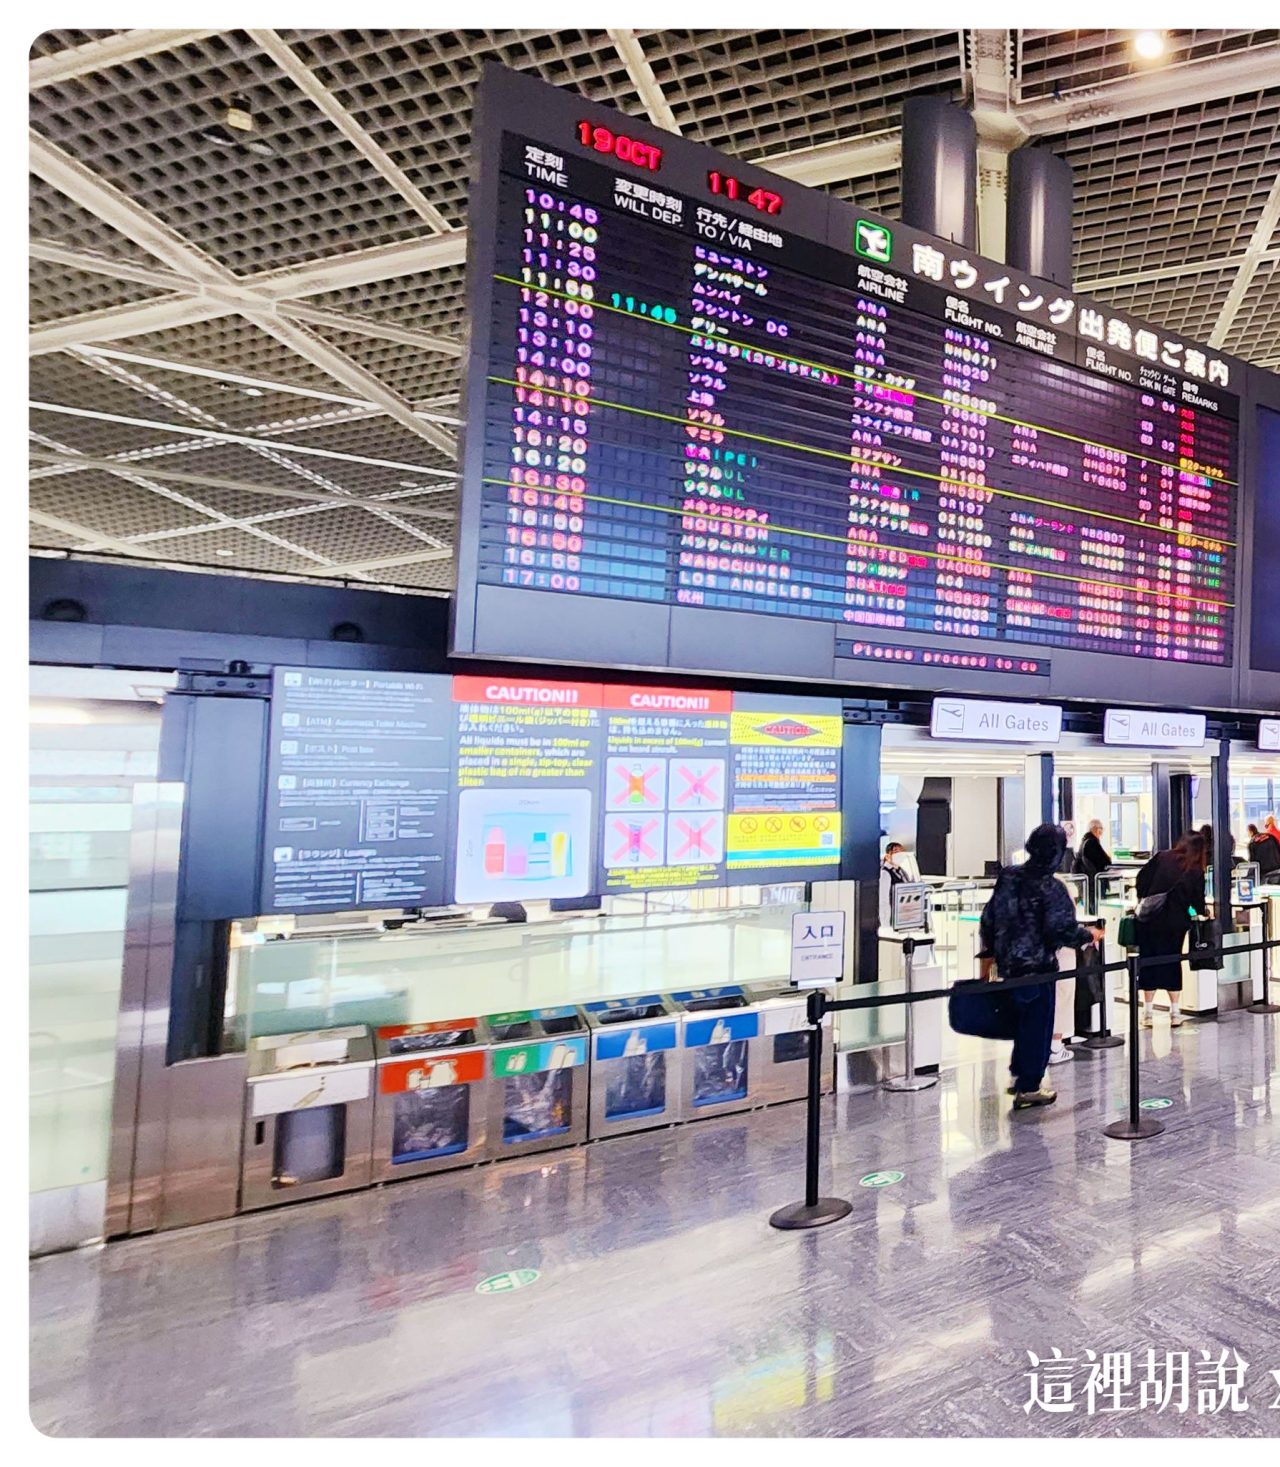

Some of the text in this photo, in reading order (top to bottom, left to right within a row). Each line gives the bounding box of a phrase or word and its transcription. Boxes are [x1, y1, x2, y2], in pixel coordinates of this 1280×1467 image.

[525, 145, 563, 171] 定刻
[524, 161, 568, 188] TIME
[525, 189, 598, 224] 10:45
[614, 177, 683, 214] 変更時刻
[613, 193, 684, 228] WILL DEP.
[524, 228, 597, 262] 11:25
[695, 221, 717, 239] TO
[728, 232, 752, 251] VIA
[523, 248, 596, 281] 11:30
[694, 245, 768, 278] ヒューストン
[521, 287, 594, 319] 12:00
[857, 279, 905, 304] AIRLINE
[857, 299, 888, 318] ANA
[520, 308, 593, 339] 13:10
[765, 320, 789, 337] DC
[856, 315, 887, 334] ANA
[944, 308, 1004, 338] FLIGHT NO.
[518, 327, 592, 358] 13:10
[855, 332, 886, 350] ANA
[944, 327, 990, 353] NH174
[1015, 334, 1055, 355] AIRLINE
[517, 347, 591, 377] 14:00
[854, 347, 886, 366] ANA
[1085, 357, 1118, 377] FLIGHT
[1181, 391, 1218, 412] REMARKS
[679, 570, 812, 600] LOS ANGELES
[845, 592, 905, 611] UNITED
[485, 685, 579, 703] CAUTION!!
[630, 693, 710, 710] CAUTION!!
[979, 711, 1049, 732] All Gates
[1141, 720, 1196, 738] All Gates
[801, 924, 834, 941] 入口
